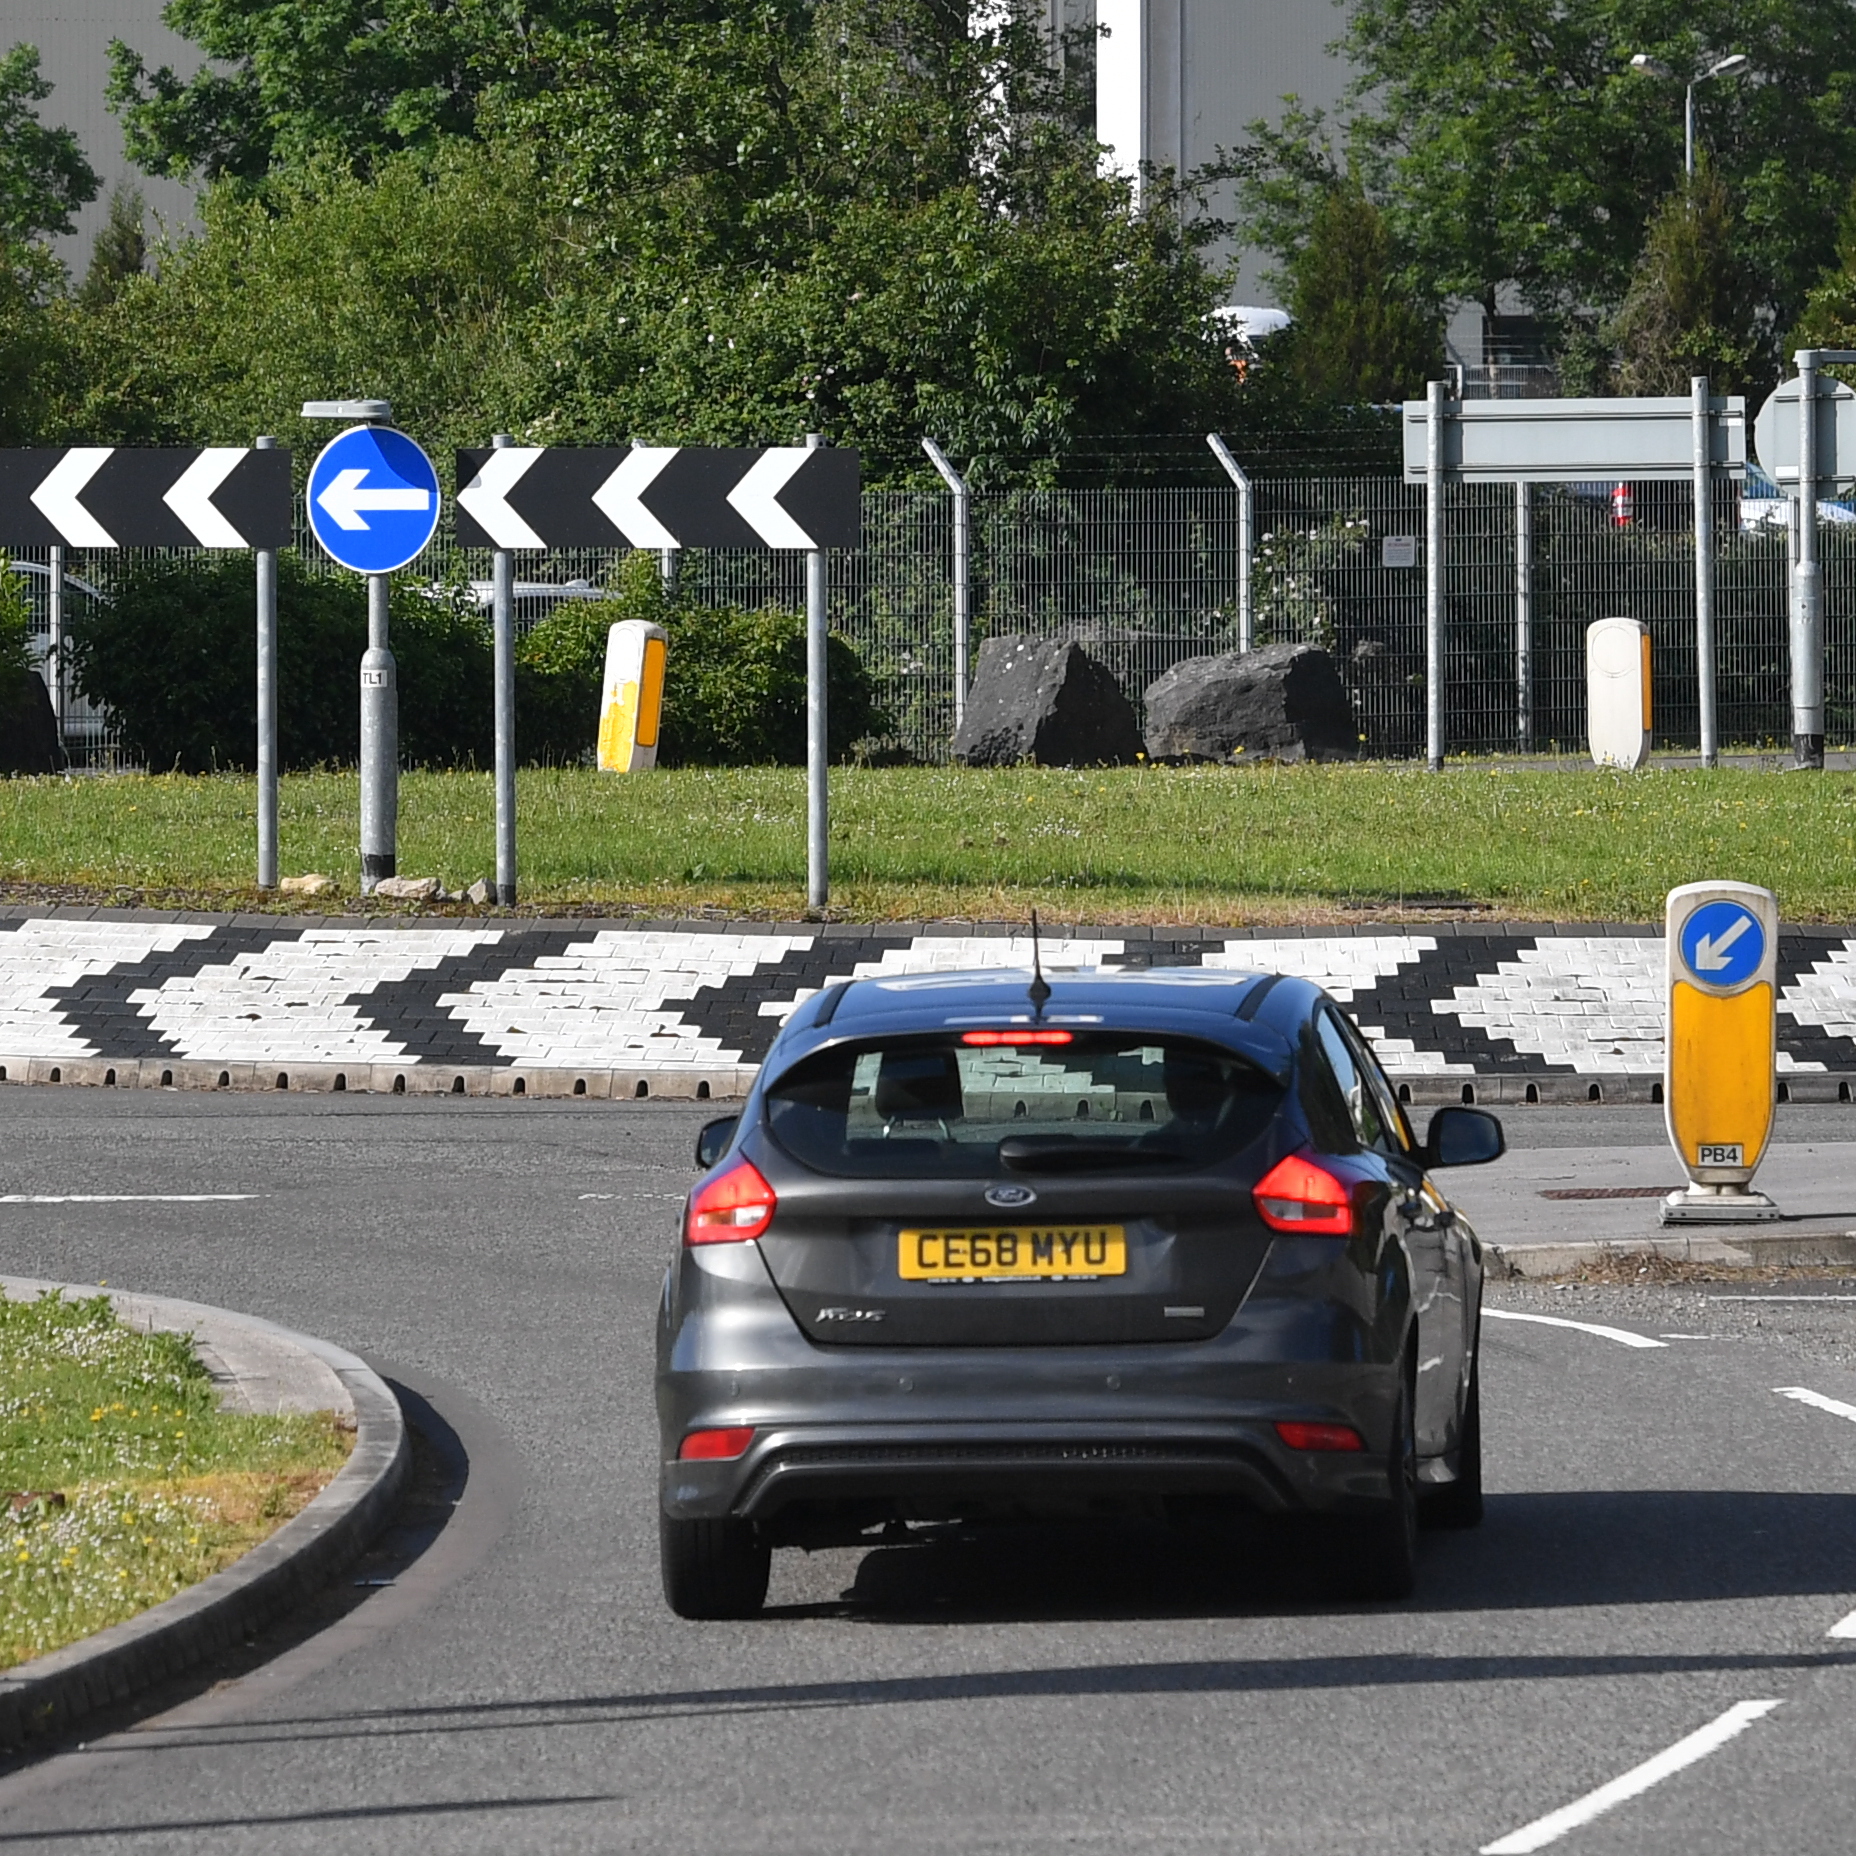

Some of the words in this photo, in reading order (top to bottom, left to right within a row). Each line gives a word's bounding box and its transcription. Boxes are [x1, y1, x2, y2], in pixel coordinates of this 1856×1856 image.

[363, 672, 382, 685] TL1
[1701, 1147, 1738, 1163] PB4
[917, 1233, 1019, 1269] CE68
[1030, 1231, 1106, 1266] MYU
